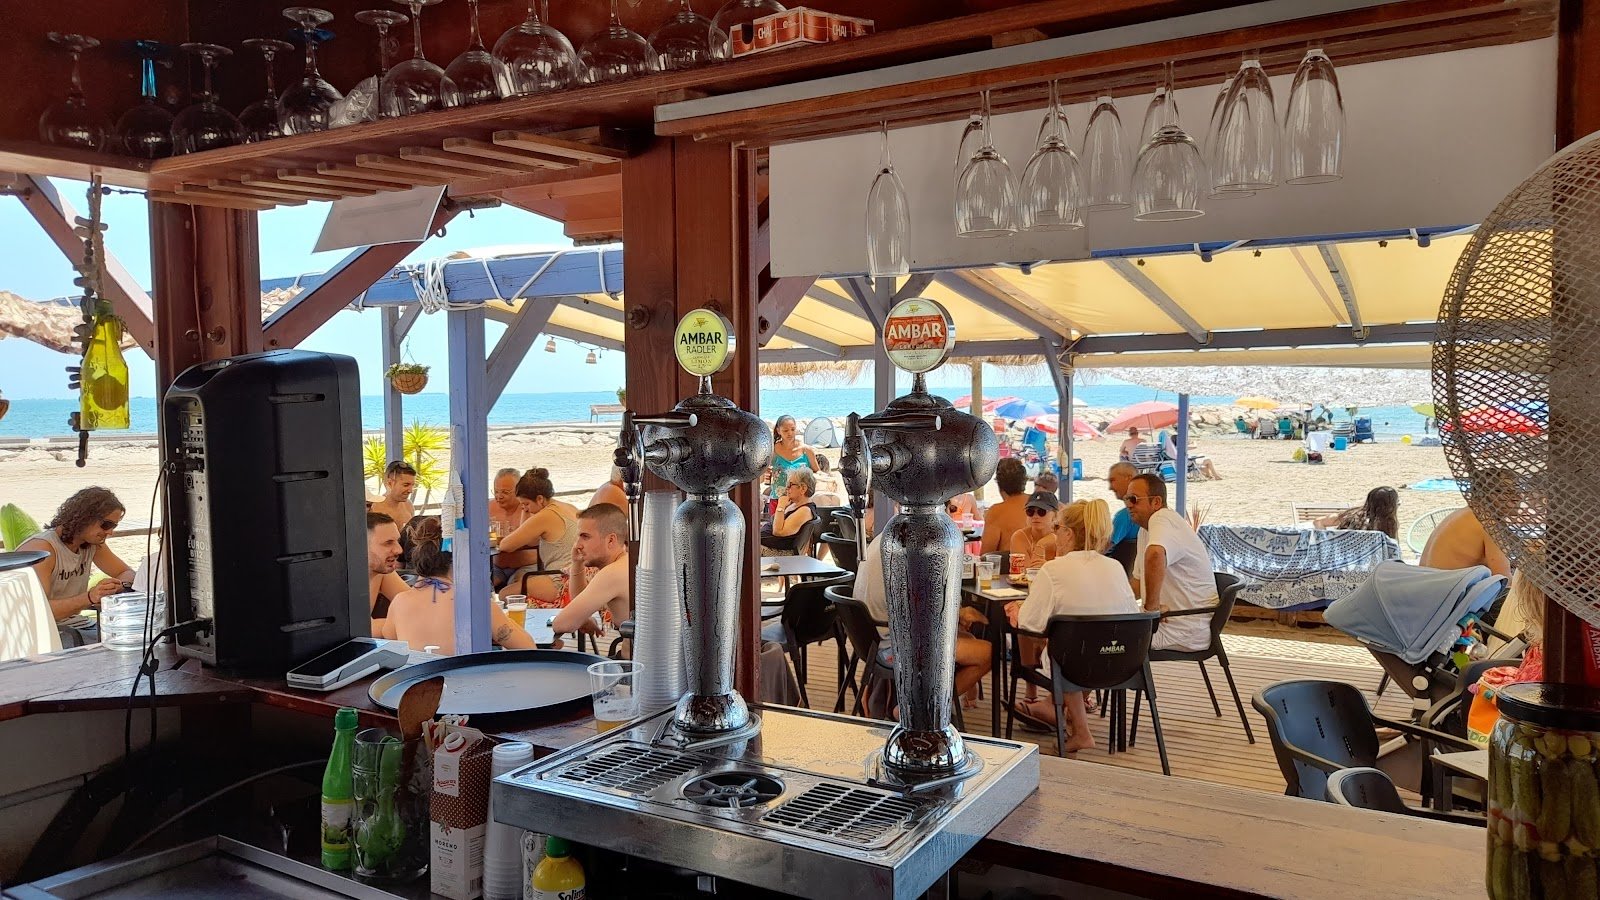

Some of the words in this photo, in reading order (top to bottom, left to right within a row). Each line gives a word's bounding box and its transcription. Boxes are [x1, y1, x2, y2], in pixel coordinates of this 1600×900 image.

[887, 322, 944, 340] AMBAR
[680, 331, 723, 345] AMBAR
[686, 345, 717, 354] RADLER
[1099, 645, 1126, 653] AMBAR
[434, 838, 458, 850] MORENO
